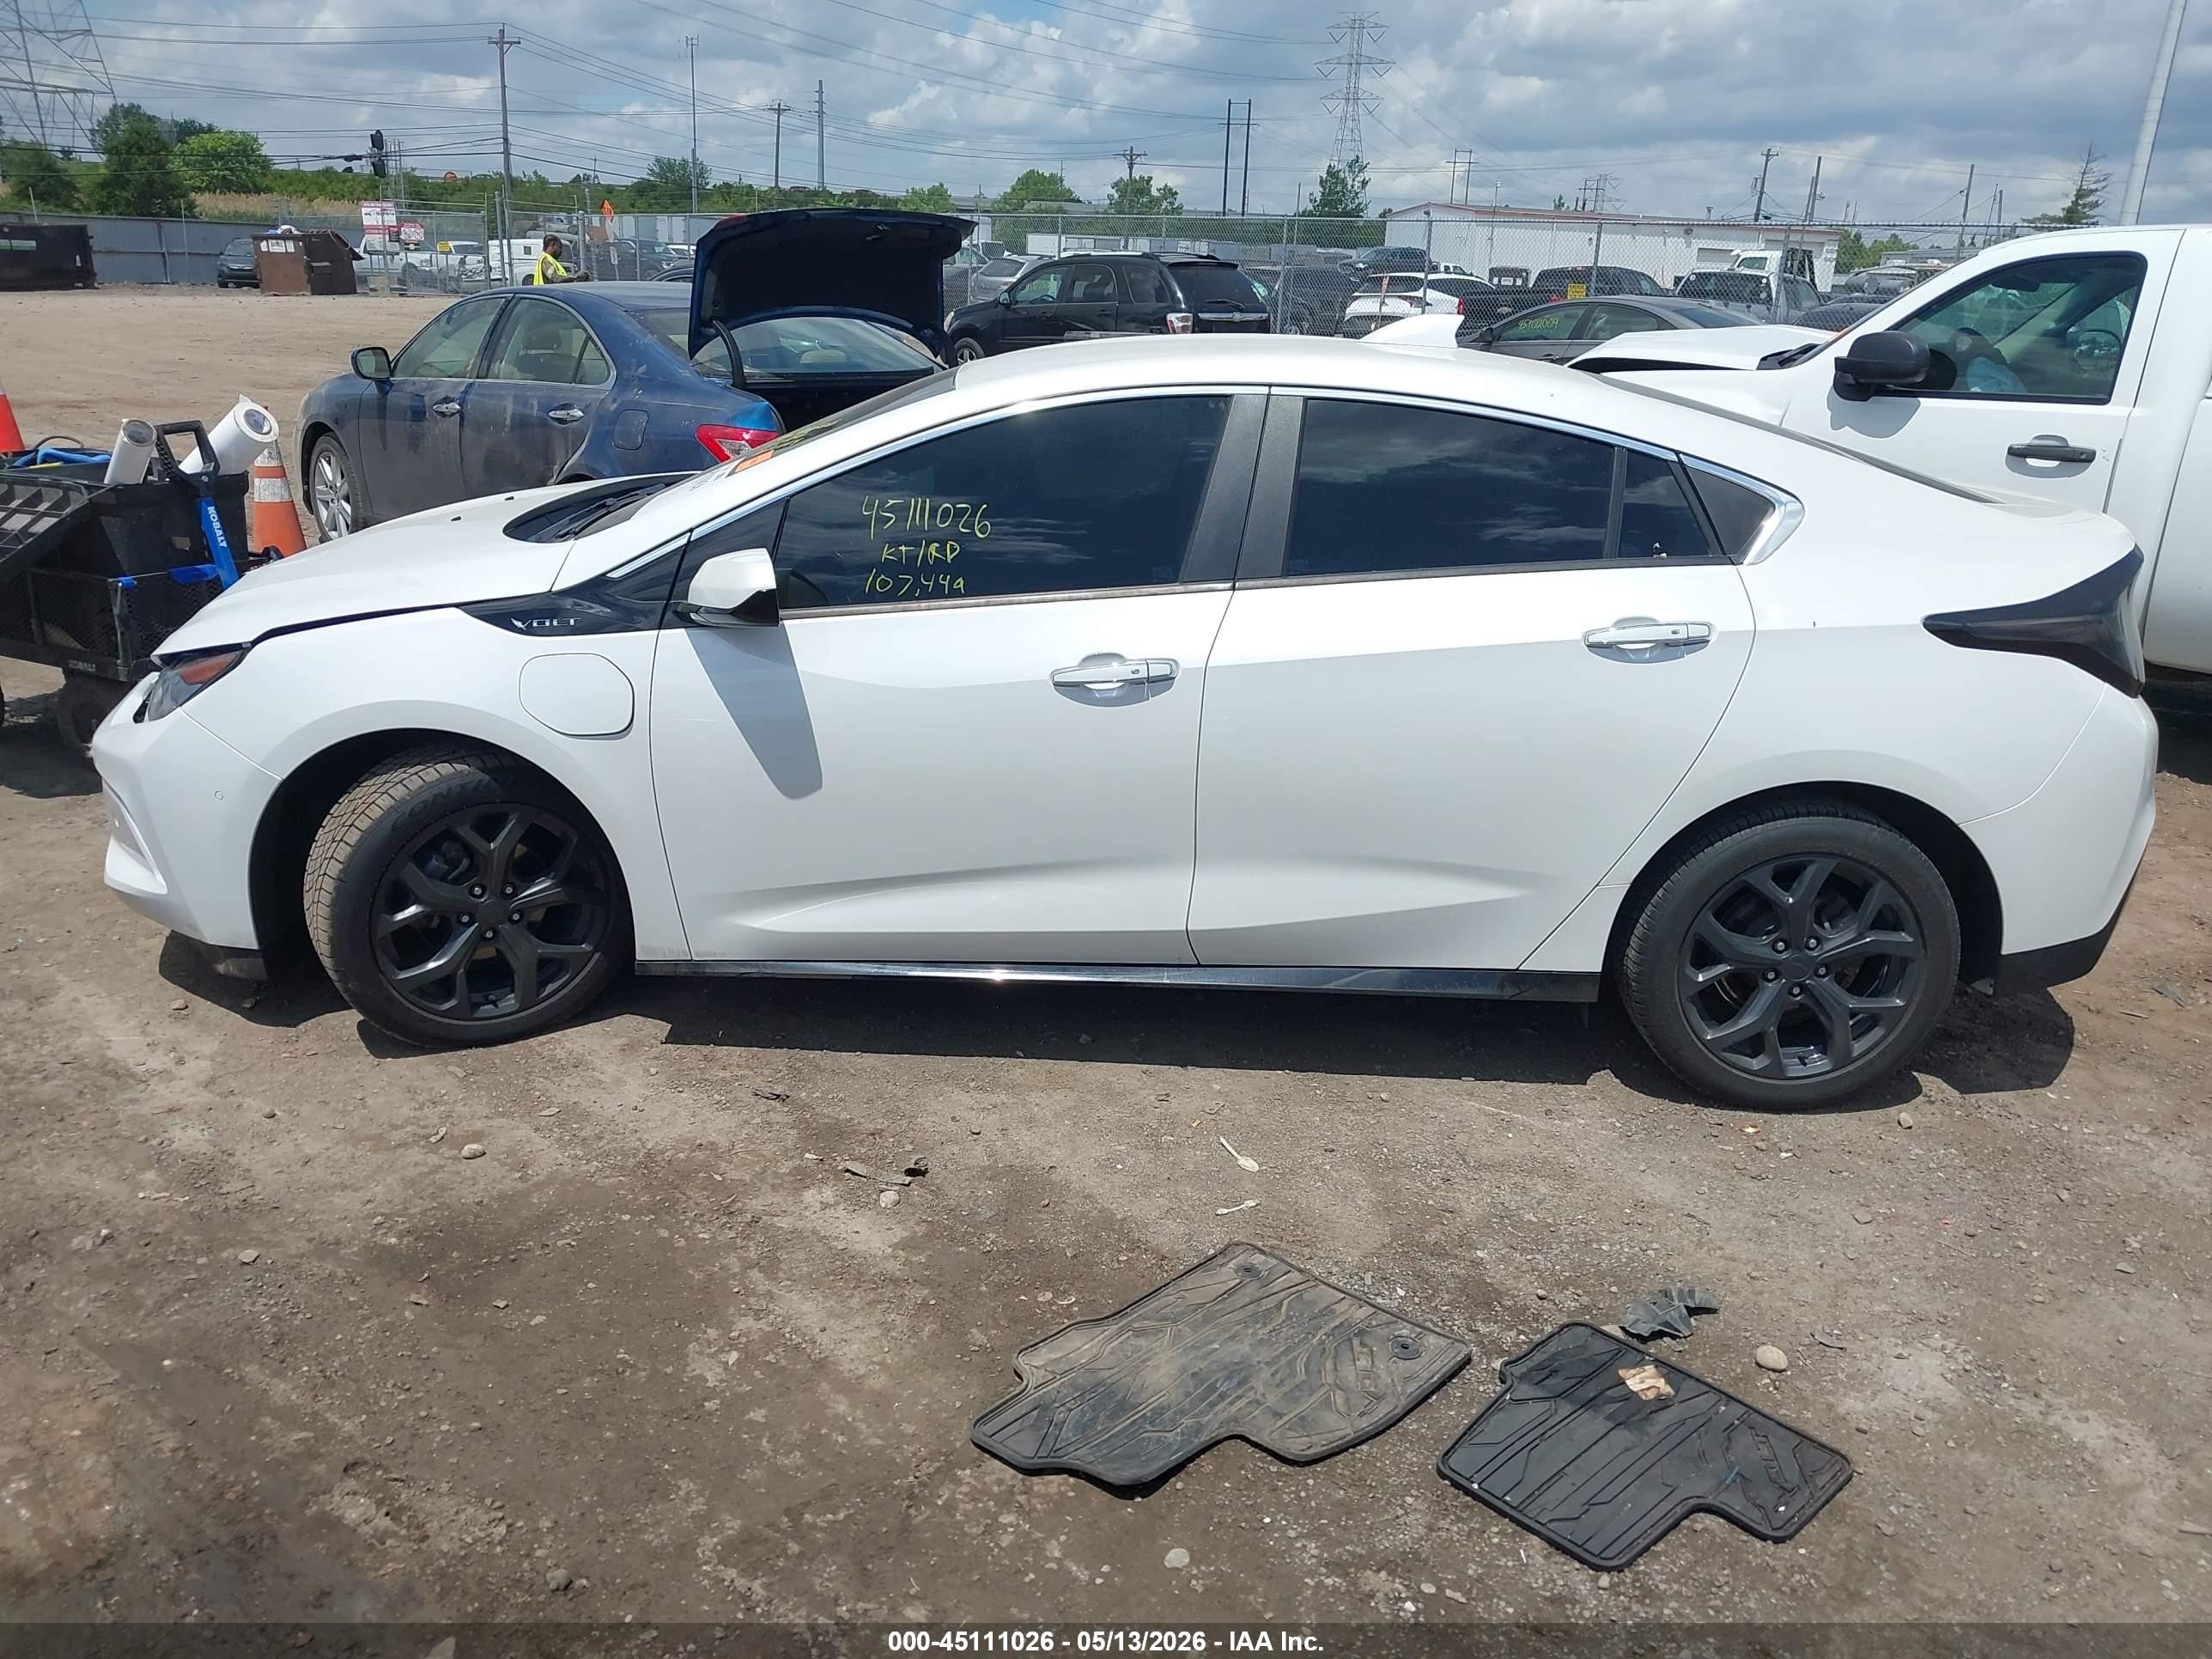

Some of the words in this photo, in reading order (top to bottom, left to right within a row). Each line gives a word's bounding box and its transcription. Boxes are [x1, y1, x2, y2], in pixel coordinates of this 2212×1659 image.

[207, 506, 228, 548] KOBALT
[861, 495, 992, 541] 45111026
[510, 617, 582, 631] VOLT
